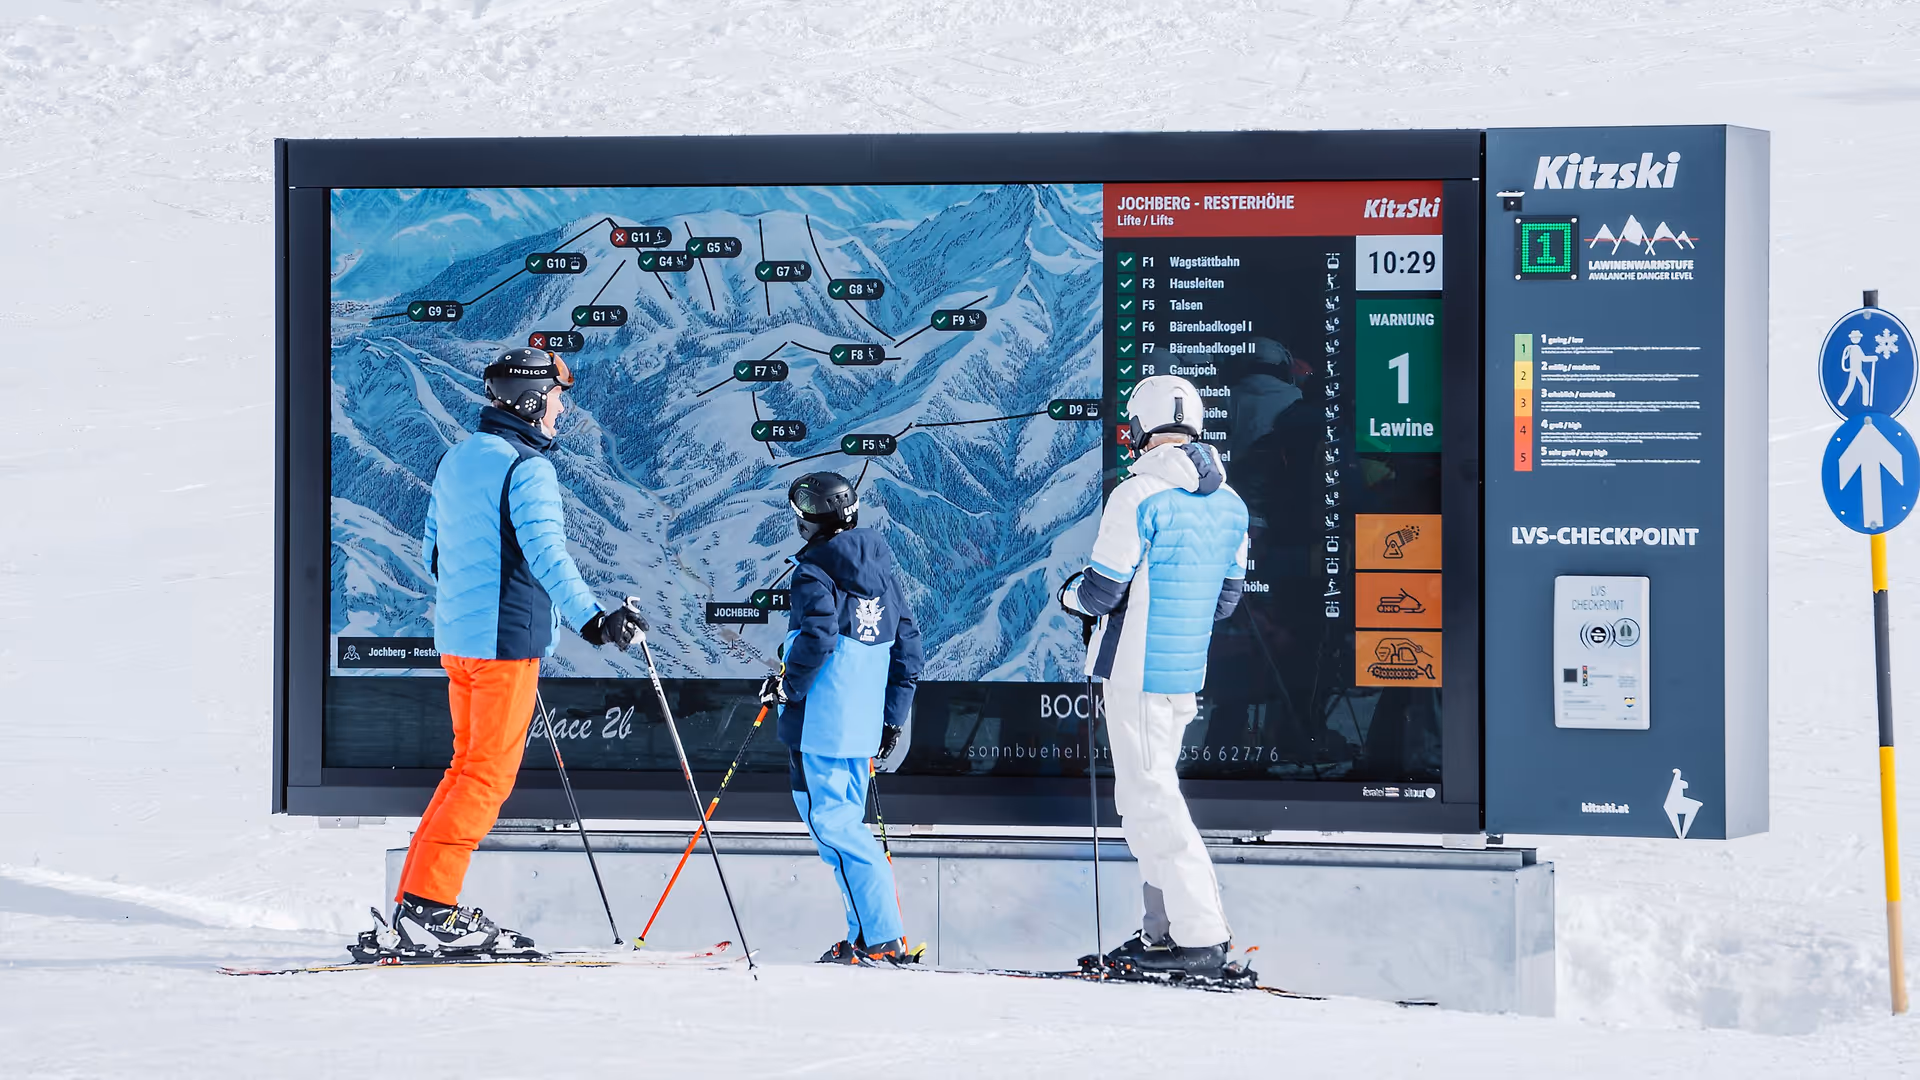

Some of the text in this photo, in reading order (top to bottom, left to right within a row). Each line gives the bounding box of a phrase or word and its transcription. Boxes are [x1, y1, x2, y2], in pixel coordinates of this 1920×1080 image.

[1118, 196, 1190, 210] JOCHBERG
[1204, 193, 1294, 209] RESTERHÖHE
[1364, 197, 1441, 218] KitzSki
[1118, 215, 1141, 225] Lifte
[1151, 215, 1173, 225] Lifts
[632, 232, 649, 242] G11
[707, 243, 720, 252] G5
[1537, 233, 1556, 264] 1
[547, 259, 565, 268] G10
[660, 256, 672, 266] G4
[1143, 256, 1239, 269] F1 Wagstättbahn
[1369, 251, 1435, 273] 10:29
[1589, 260, 1694, 270] LAWINENWARNSTUFE
[777, 267, 789, 276] G7
[1589, 272, 1693, 280] AVALANCHE DANGER LEVEL
[1143, 278, 1224, 288] F3 Hausleiten
[849, 284, 862, 294] G8
[1143, 300, 1154, 310] F5
[1170, 299, 1203, 310] Talsen
[429, 306, 441, 316] G9
[593, 311, 604, 321] G1
[953, 315, 964, 325] F9
[1369, 314, 1434, 326] WARNUNG
[1143, 322, 1154, 331] F6
[1170, 321, 1245, 333] Bärenbadkogel
[550, 337, 563, 346] G2
[1143, 343, 1154, 353] F7
[1170, 342, 1245, 355] Bärenbadkogel
[852, 350, 863, 360] F8
[1541, 361, 1548, 370] 2
[755, 366, 766, 376] F7
[1142, 364, 1217, 379] F8 Gauxjoch
[1521, 371, 1527, 381] 2
[1389, 353, 1409, 403] 1
[1541, 389, 1548, 398] 3
[1520, 398, 1527, 408] 3
[1070, 405, 1082, 414] D9
[1202, 405, 1227, 419] höhe
[1370, 418, 1433, 436] Lawine
[1541, 420, 1548, 429] 4
[773, 426, 784, 436] F6
[1520, 426, 1527, 436] 4
[863, 440, 874, 449] F5
[1541, 447, 1547, 456] 5
[1520, 453, 1526, 462] 5
[1512, 527, 1699, 545] LVS-CHECKPOINT
[1243, 581, 1269, 592] höhe
[1590, 585, 1607, 597] LVS
[773, 595, 783, 605] F1
[1571, 599, 1625, 611] CHECKPOINT
[714, 608, 759, 617] JOCHBERG
[369, 647, 405, 658] Jochberg
[602, 706, 634, 739] 2b
[1179, 746, 1212, 762] 356
